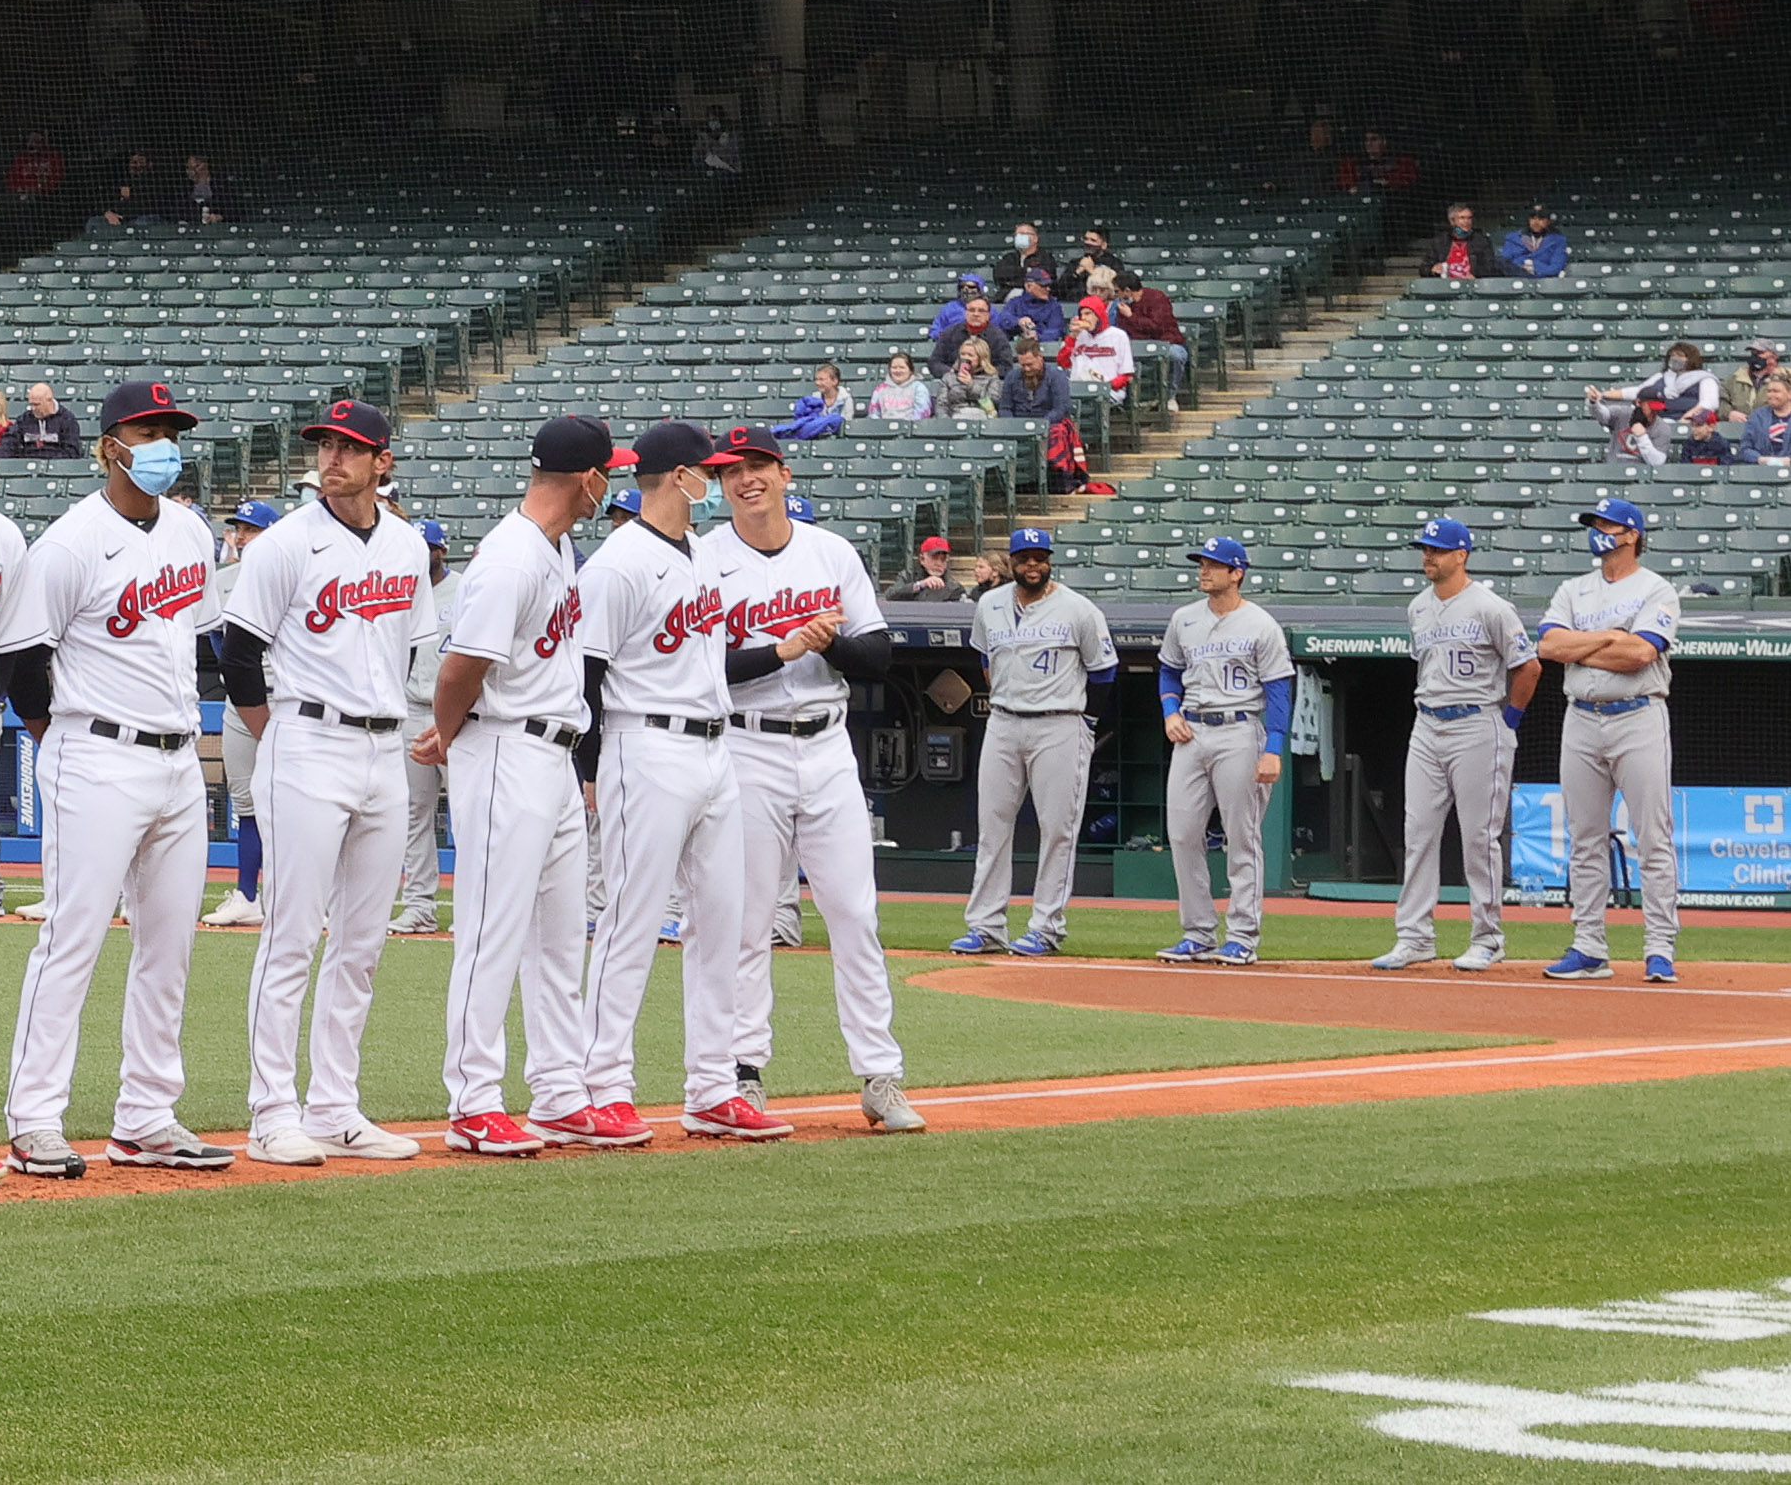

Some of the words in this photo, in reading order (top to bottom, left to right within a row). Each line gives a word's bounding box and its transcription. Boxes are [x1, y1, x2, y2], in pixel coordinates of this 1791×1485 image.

[150, 382, 171, 407] C
[329, 399, 355, 421] C
[728, 425, 749, 447] C
[1023, 527, 1040, 544] KC
[652, 583, 723, 654] India
[1037, 622, 1072, 646] City
[1304, 636, 1413, 654] SHERWIN-WIL
[1417, 622, 1449, 648] ansas
[1449, 617, 1484, 645] City
[1032, 649, 1059, 676] 41
[1184, 639, 1226, 662] ansas
[1446, 647, 1476, 678] 15
[1221, 664, 1249, 692] 16
[20, 734, 36, 828] PROGRESSIVE
